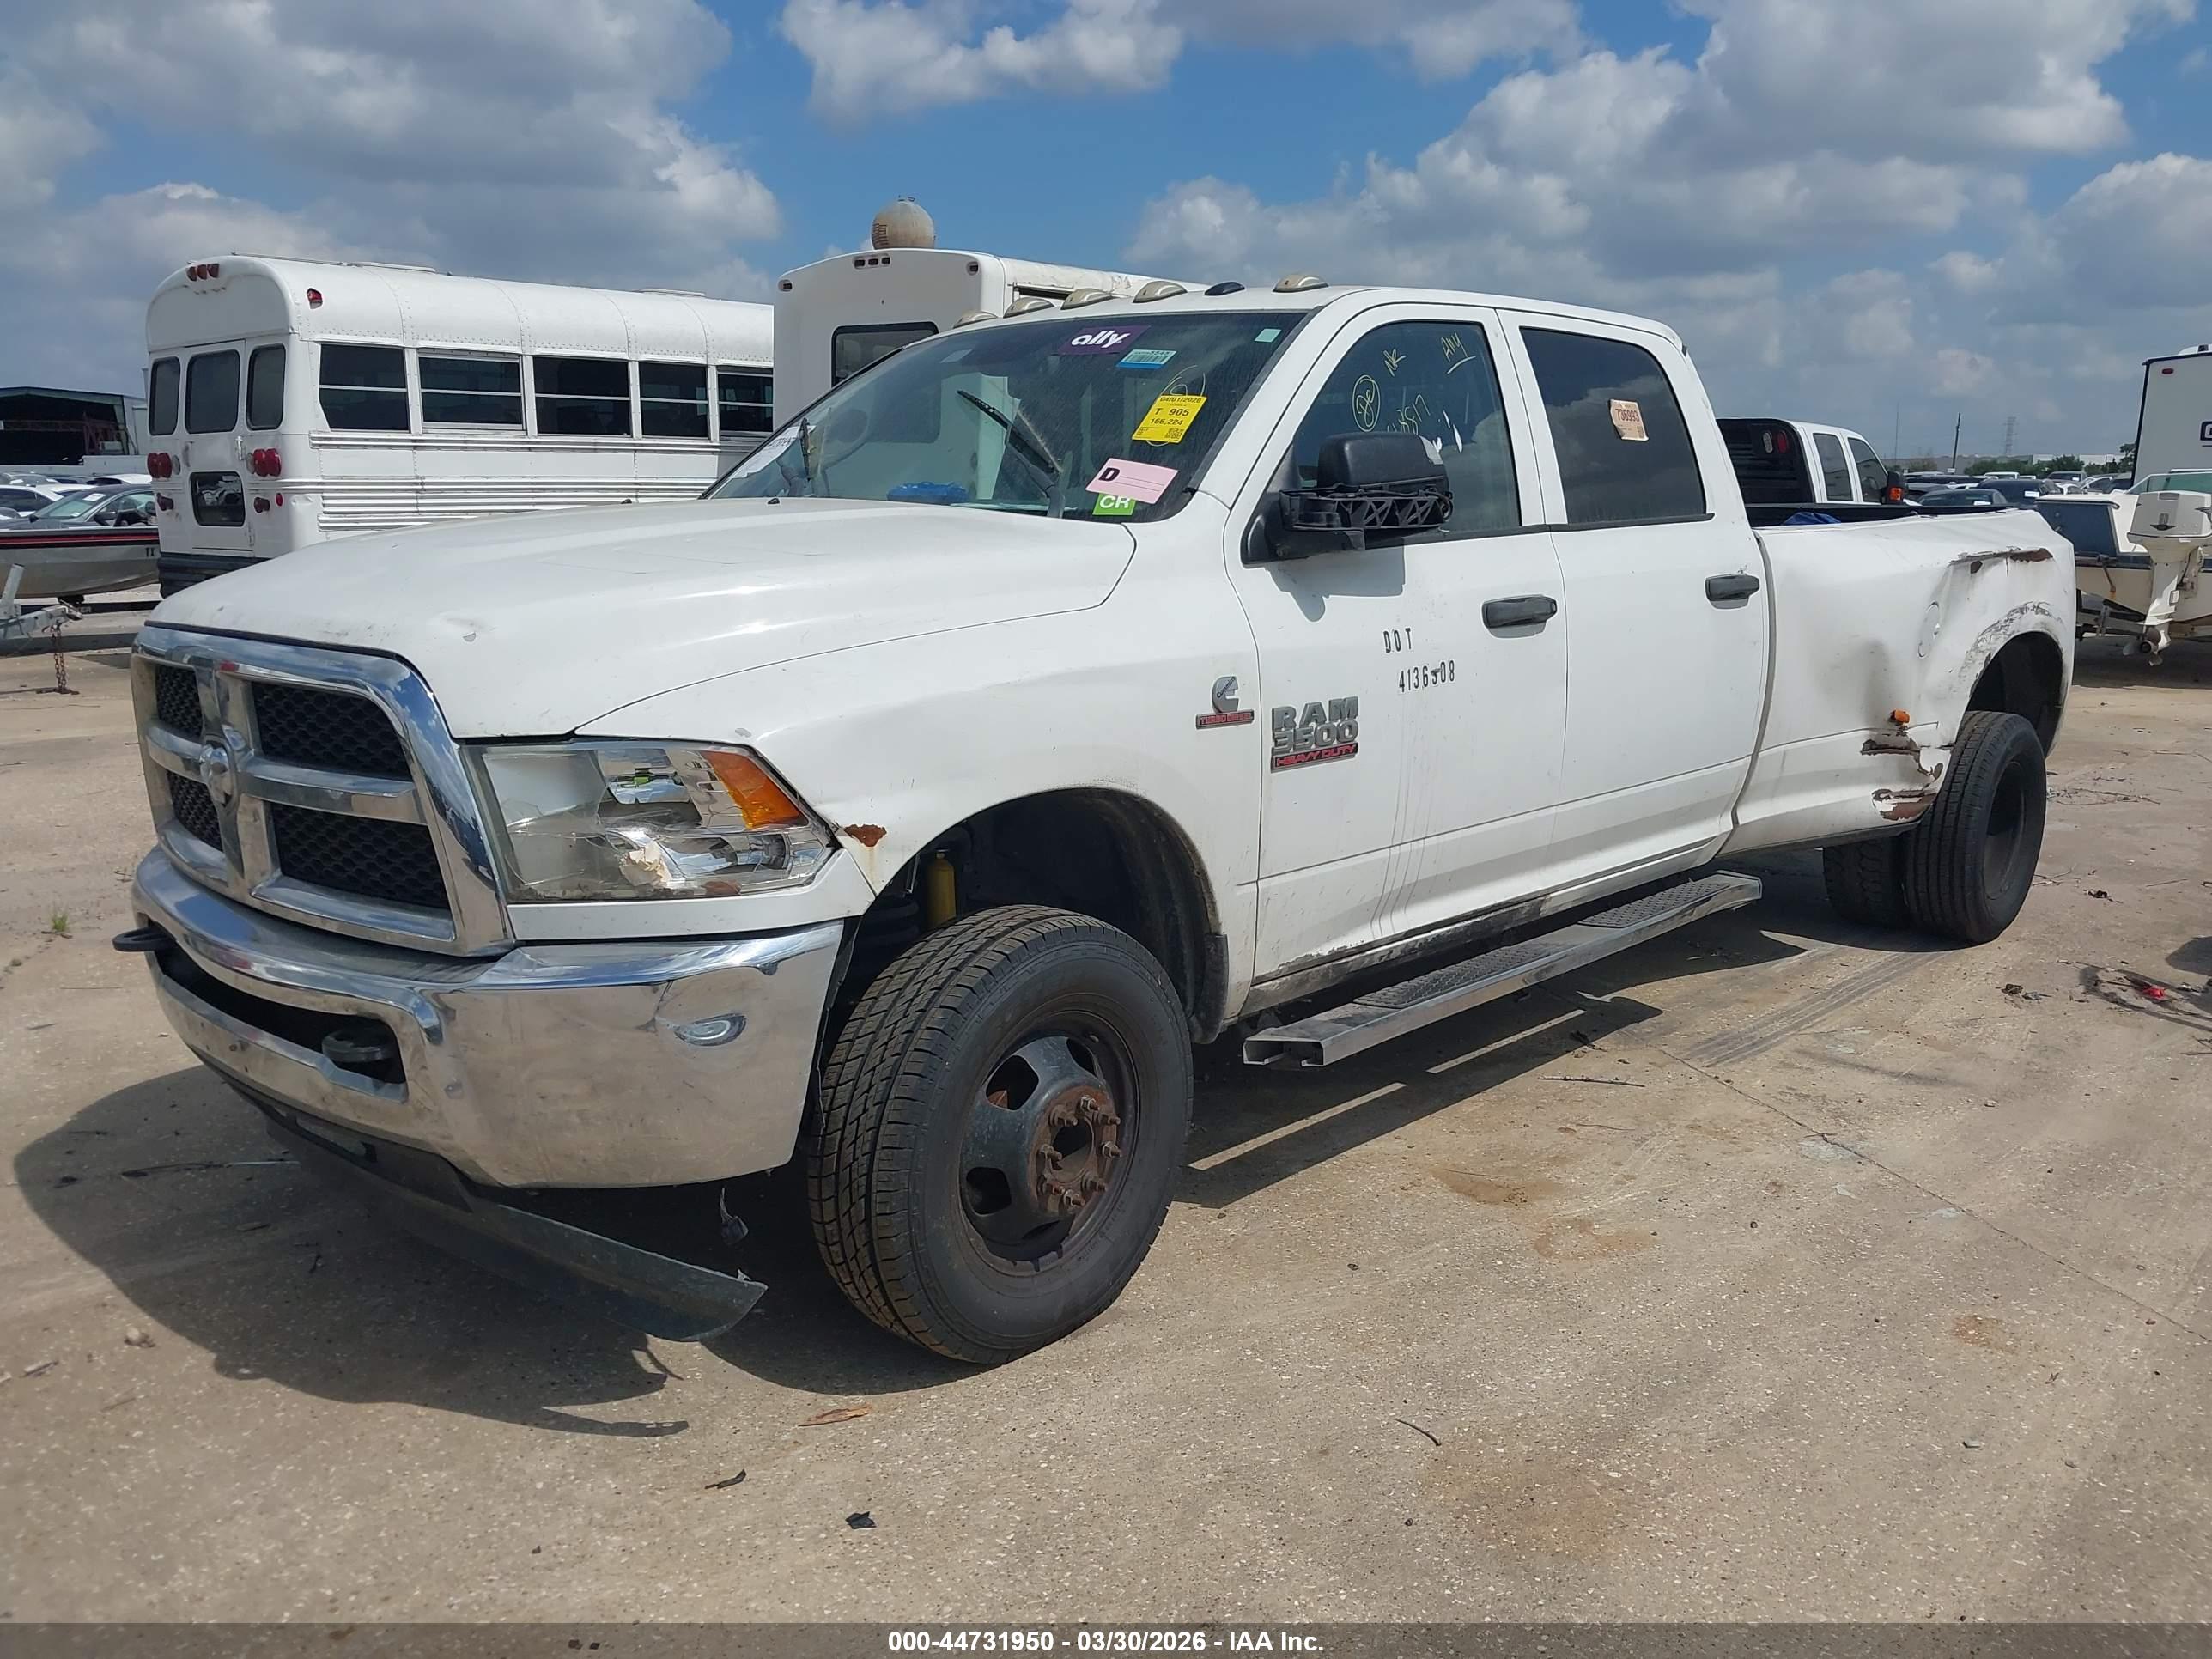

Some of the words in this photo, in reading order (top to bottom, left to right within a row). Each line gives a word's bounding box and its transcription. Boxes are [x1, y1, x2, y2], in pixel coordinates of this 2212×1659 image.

[1071, 330, 1131, 349] ally
[1168, 408, 1191, 416] 905
[1098, 467, 1121, 482] D
[1099, 495, 1131, 508] CR
[1383, 627, 1412, 653] DOT
[1272, 696, 1359, 730] RAM
[1273, 720, 1359, 753] 3500
[1276, 750, 1320, 768] HEAVY
[1322, 744, 1356, 759] DUTY
